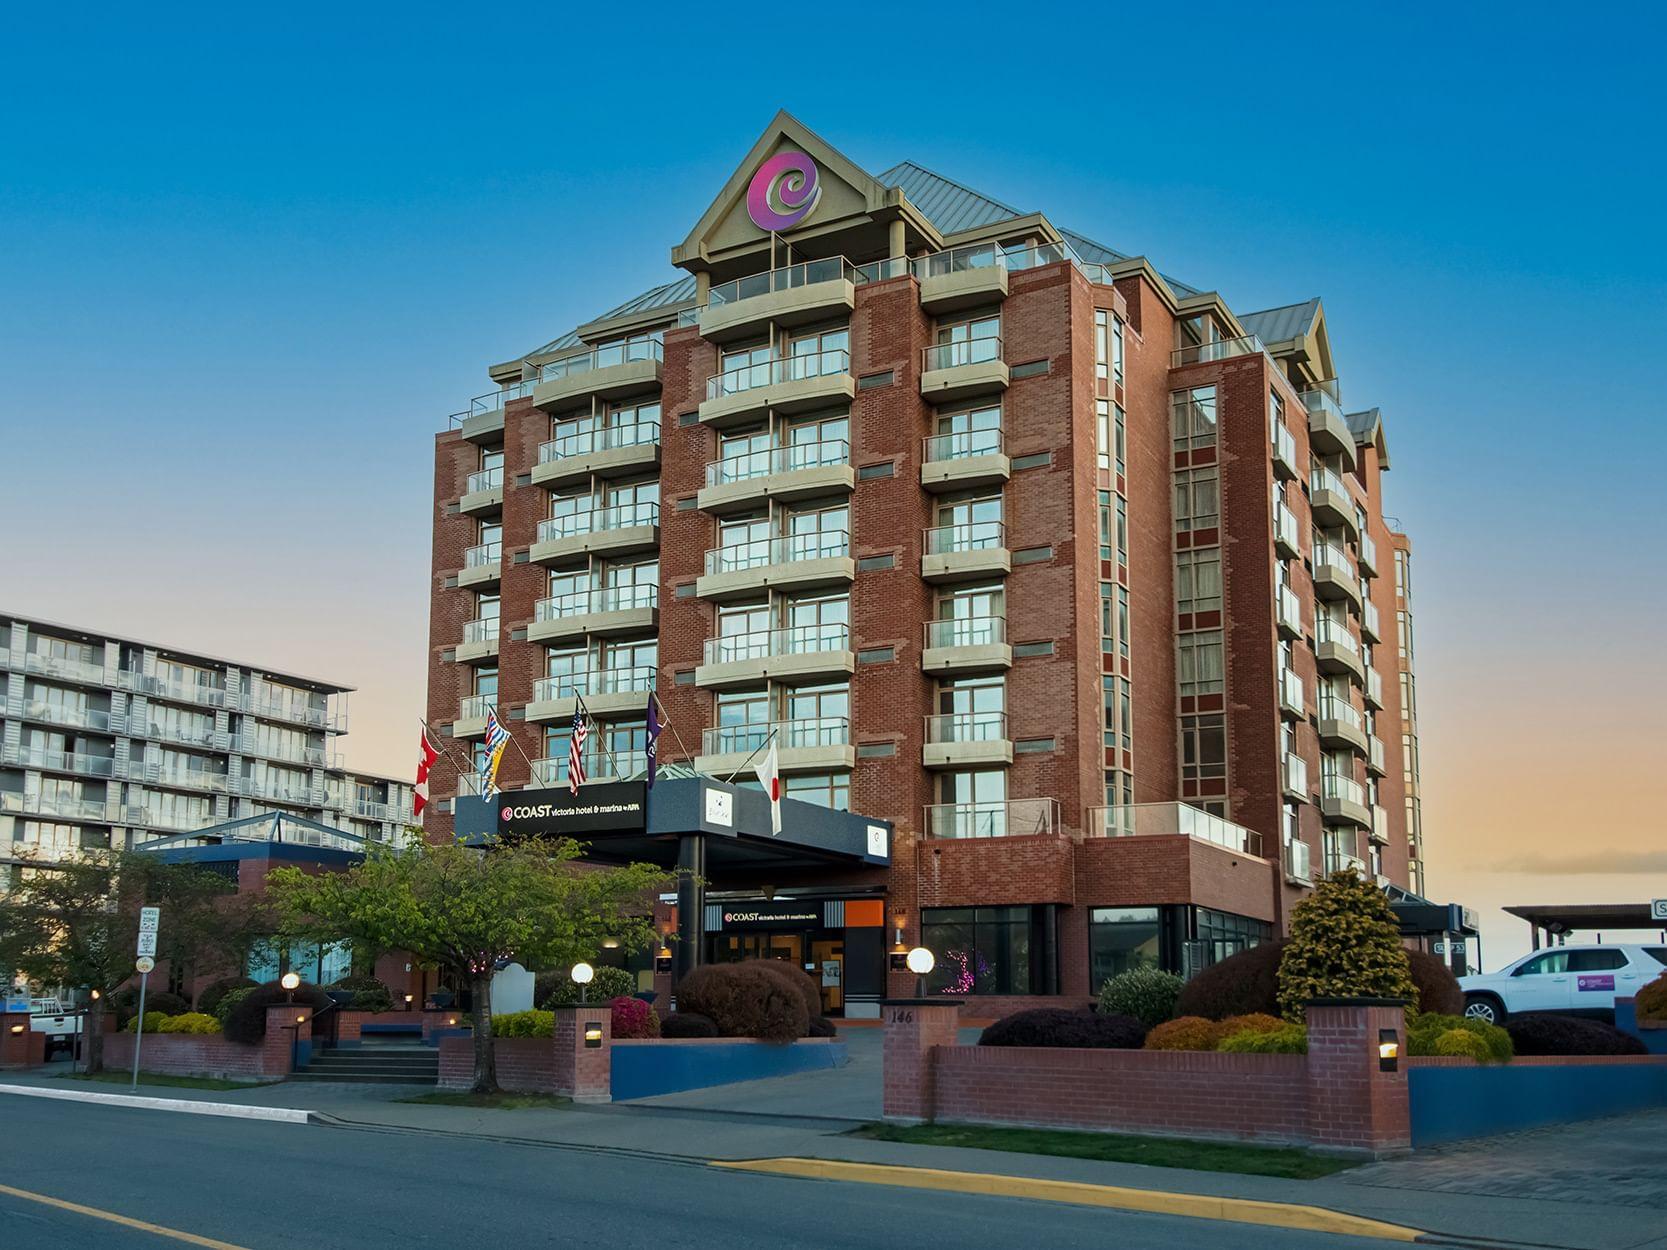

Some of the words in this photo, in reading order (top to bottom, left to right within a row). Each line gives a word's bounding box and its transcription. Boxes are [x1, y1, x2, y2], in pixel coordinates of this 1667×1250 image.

[514, 804, 552, 819] COAST
[551, 807, 575, 817] victoria
[576, 805, 593, 815] hotel
[600, 804, 622, 813] marina
[1660, 903, 1667, 913] S
[733, 912, 759, 921] COAST
[892, 1011, 912, 1024] 146
